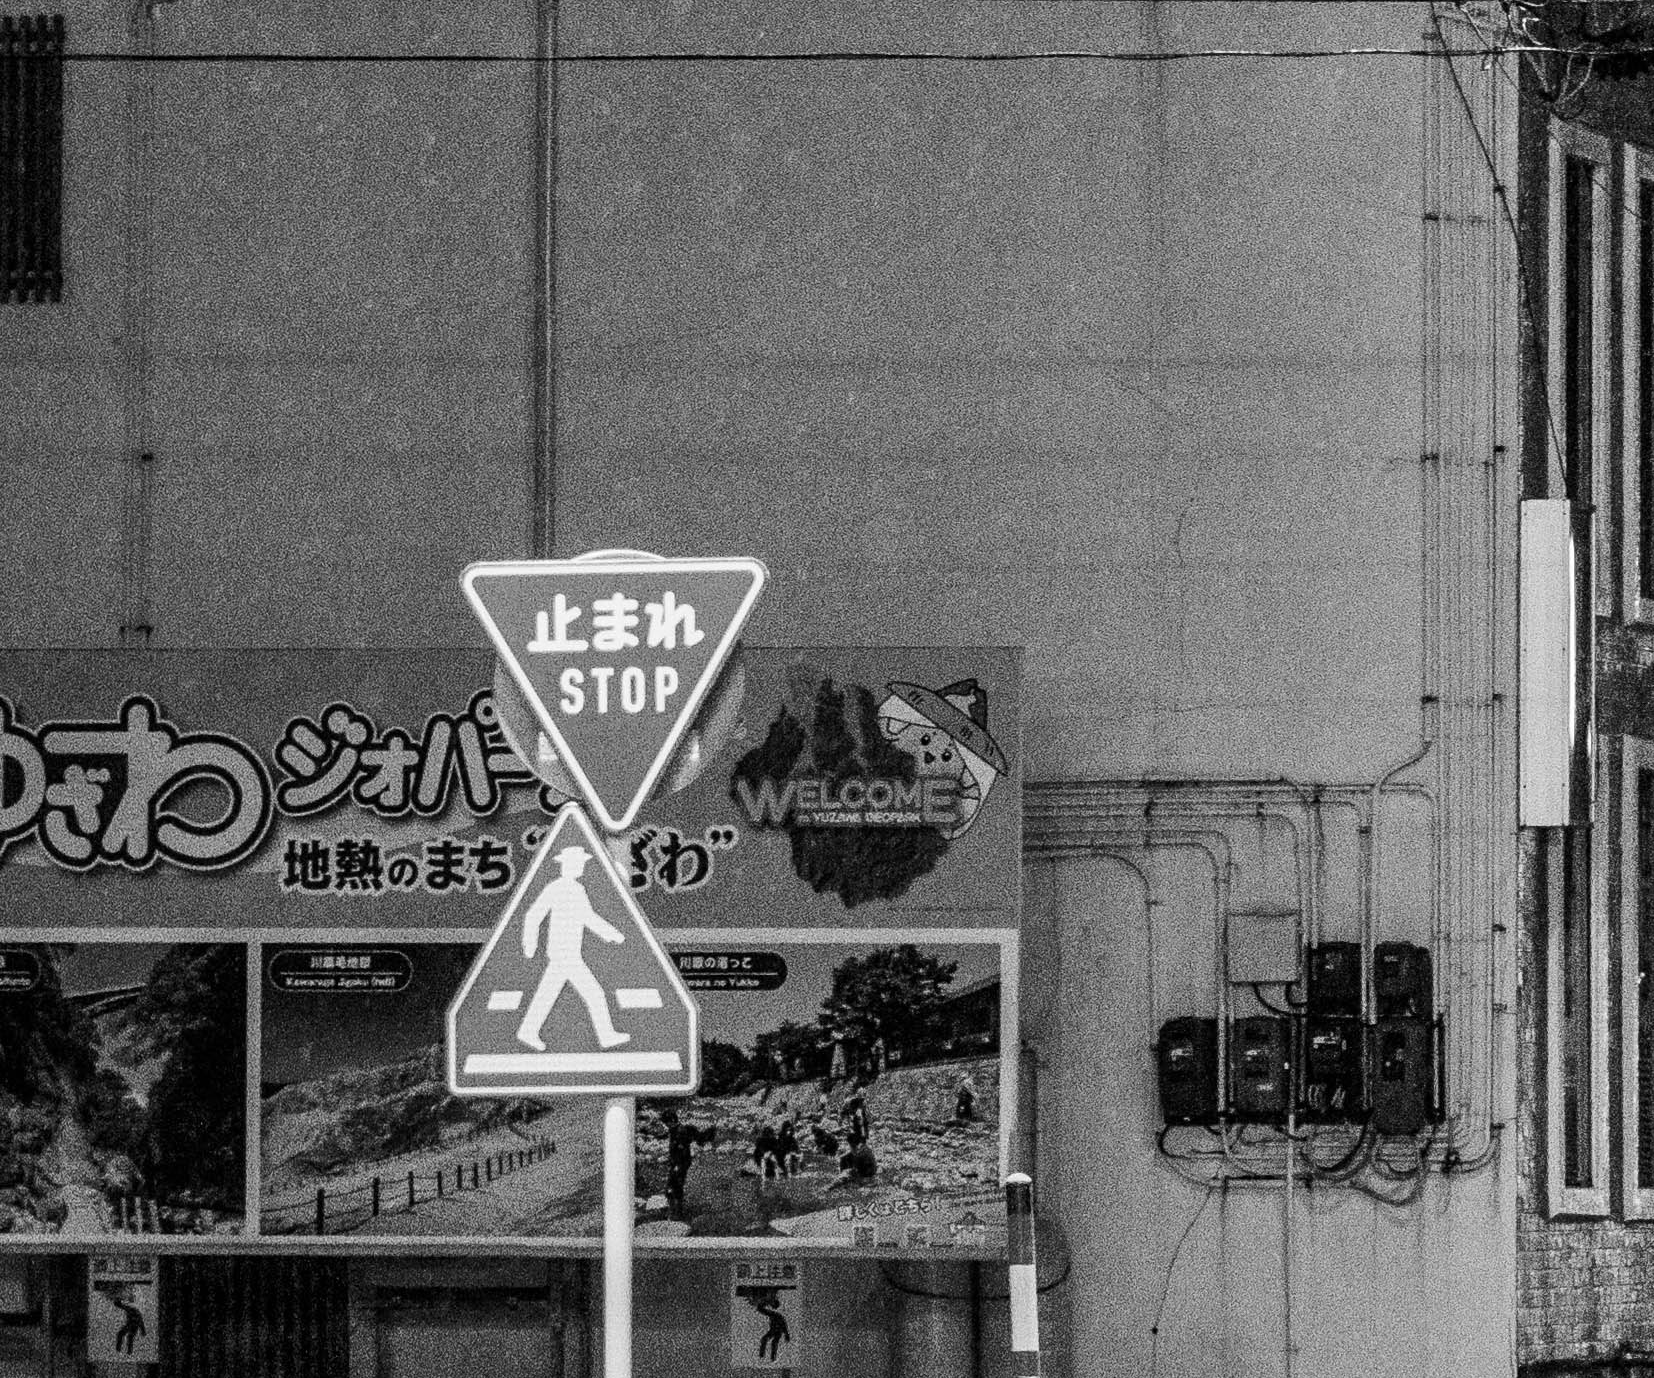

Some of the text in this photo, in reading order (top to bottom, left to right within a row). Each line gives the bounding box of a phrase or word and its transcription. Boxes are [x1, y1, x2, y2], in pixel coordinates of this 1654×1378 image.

[525, 590, 705, 655] 止まれ
[557, 664, 681, 715] STOP
[276, 688, 568, 815] ジオパー
[736, 778, 960, 823] WELCOME
